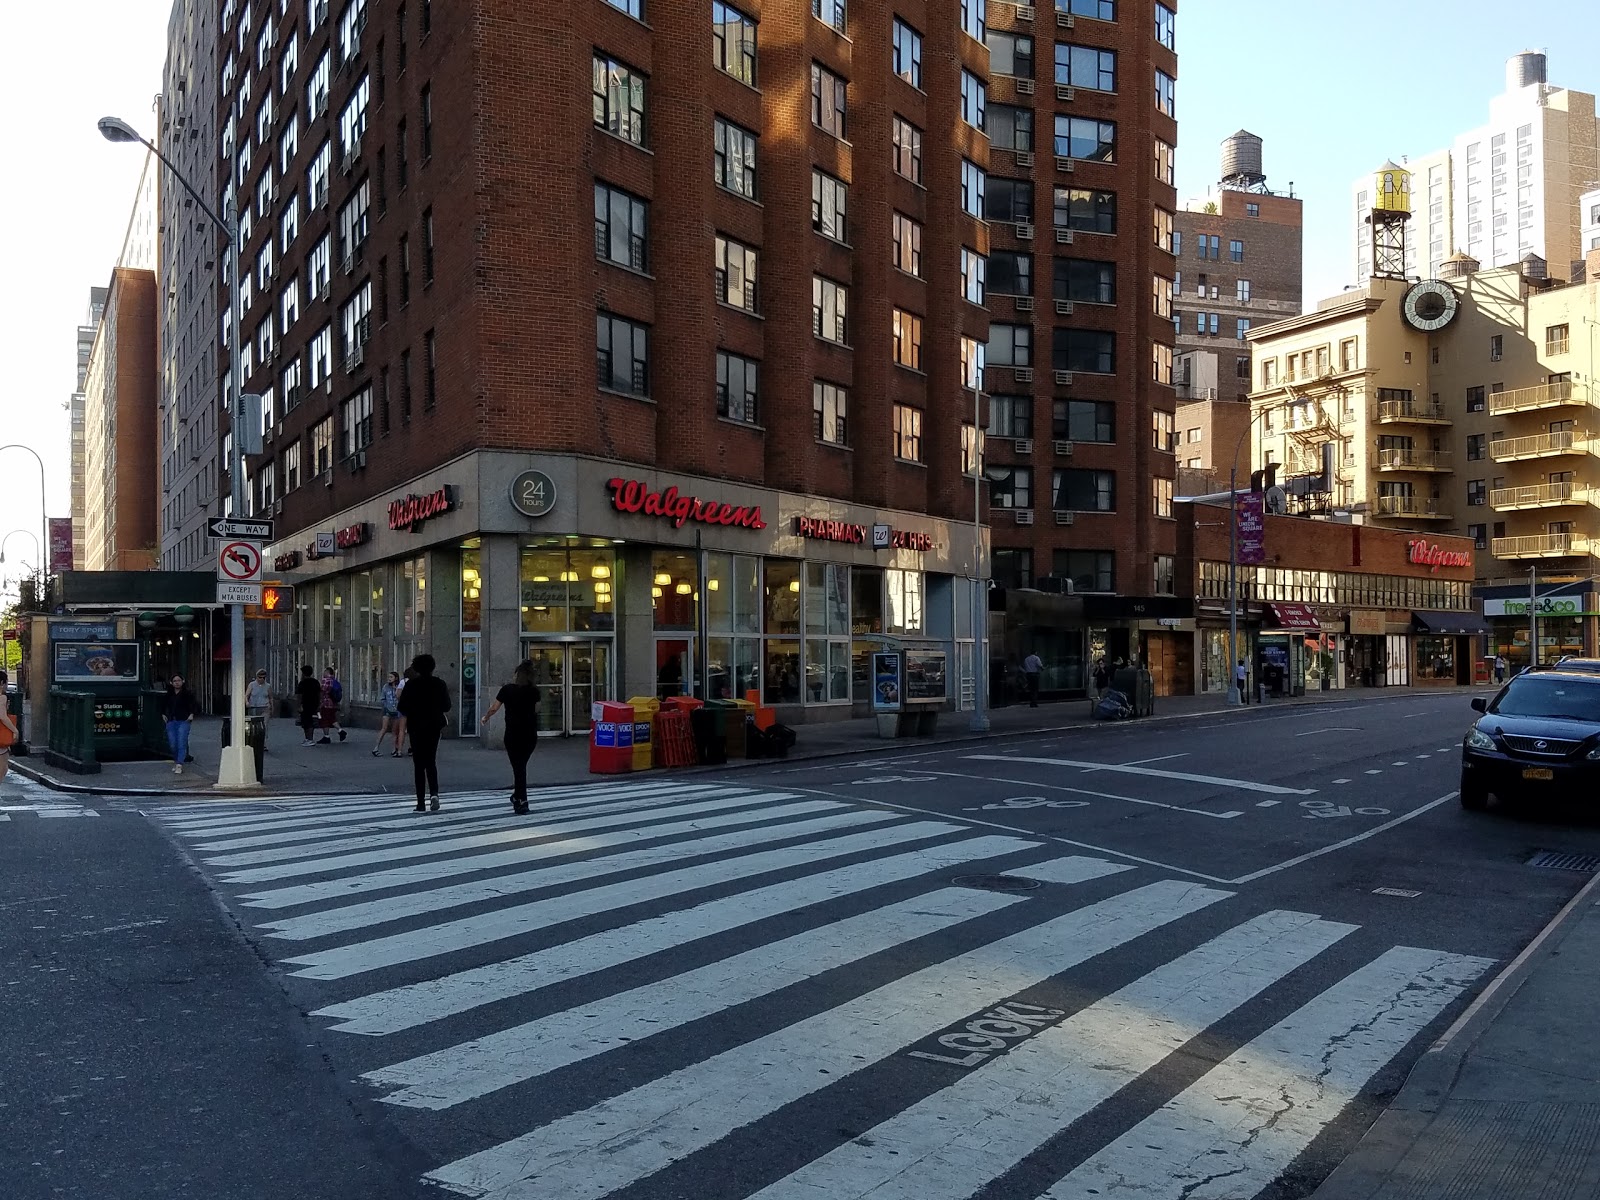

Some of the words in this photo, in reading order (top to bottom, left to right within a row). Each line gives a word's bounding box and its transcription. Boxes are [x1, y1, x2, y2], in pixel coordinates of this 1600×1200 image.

[523, 480, 545, 498] 24
[388, 485, 449, 533] Walgreens
[523, 498, 544, 506] hours
[609, 477, 767, 528] Walgreens
[218, 524, 237, 532] ONE
[245, 525, 265, 533] WAY
[800, 516, 867, 543] PHARMACY
[909, 531, 932, 551] HRS
[1409, 540, 1471, 573] Walgreens
[597, 723, 615, 731] VOICE
